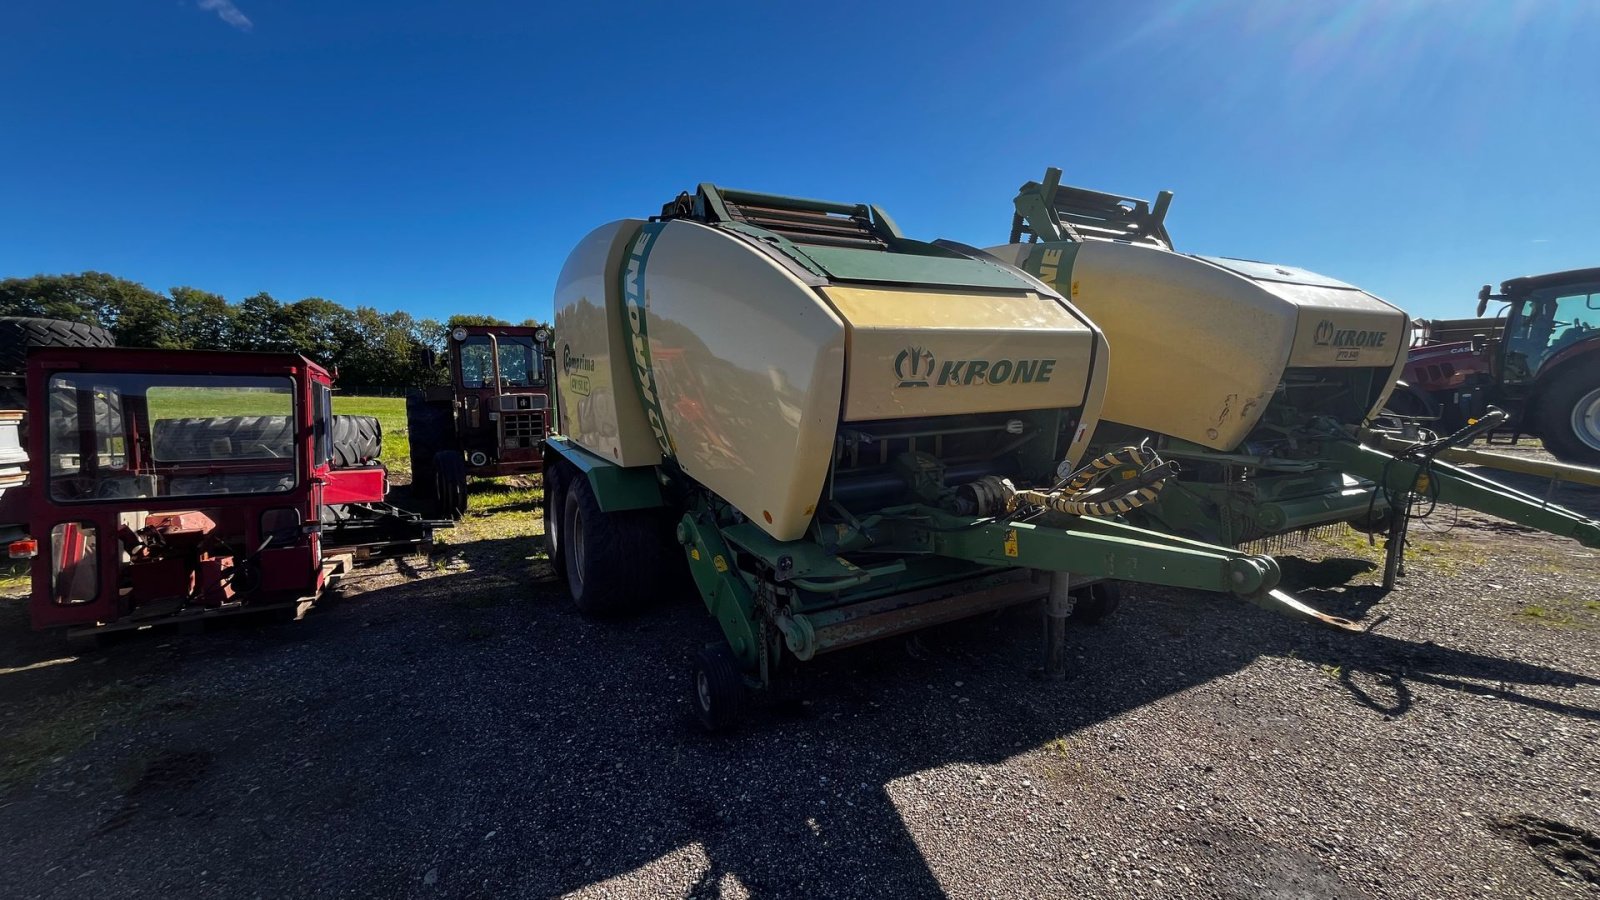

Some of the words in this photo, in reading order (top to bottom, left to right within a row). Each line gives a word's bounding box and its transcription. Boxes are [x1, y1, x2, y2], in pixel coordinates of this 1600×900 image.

[624, 232, 655, 405] KRONE
[1332, 329, 1387, 347] KRONE
[1451, 346, 1471, 354] CAS
[563, 343, 595, 377] Comprima
[936, 359, 1056, 386] KRONE
